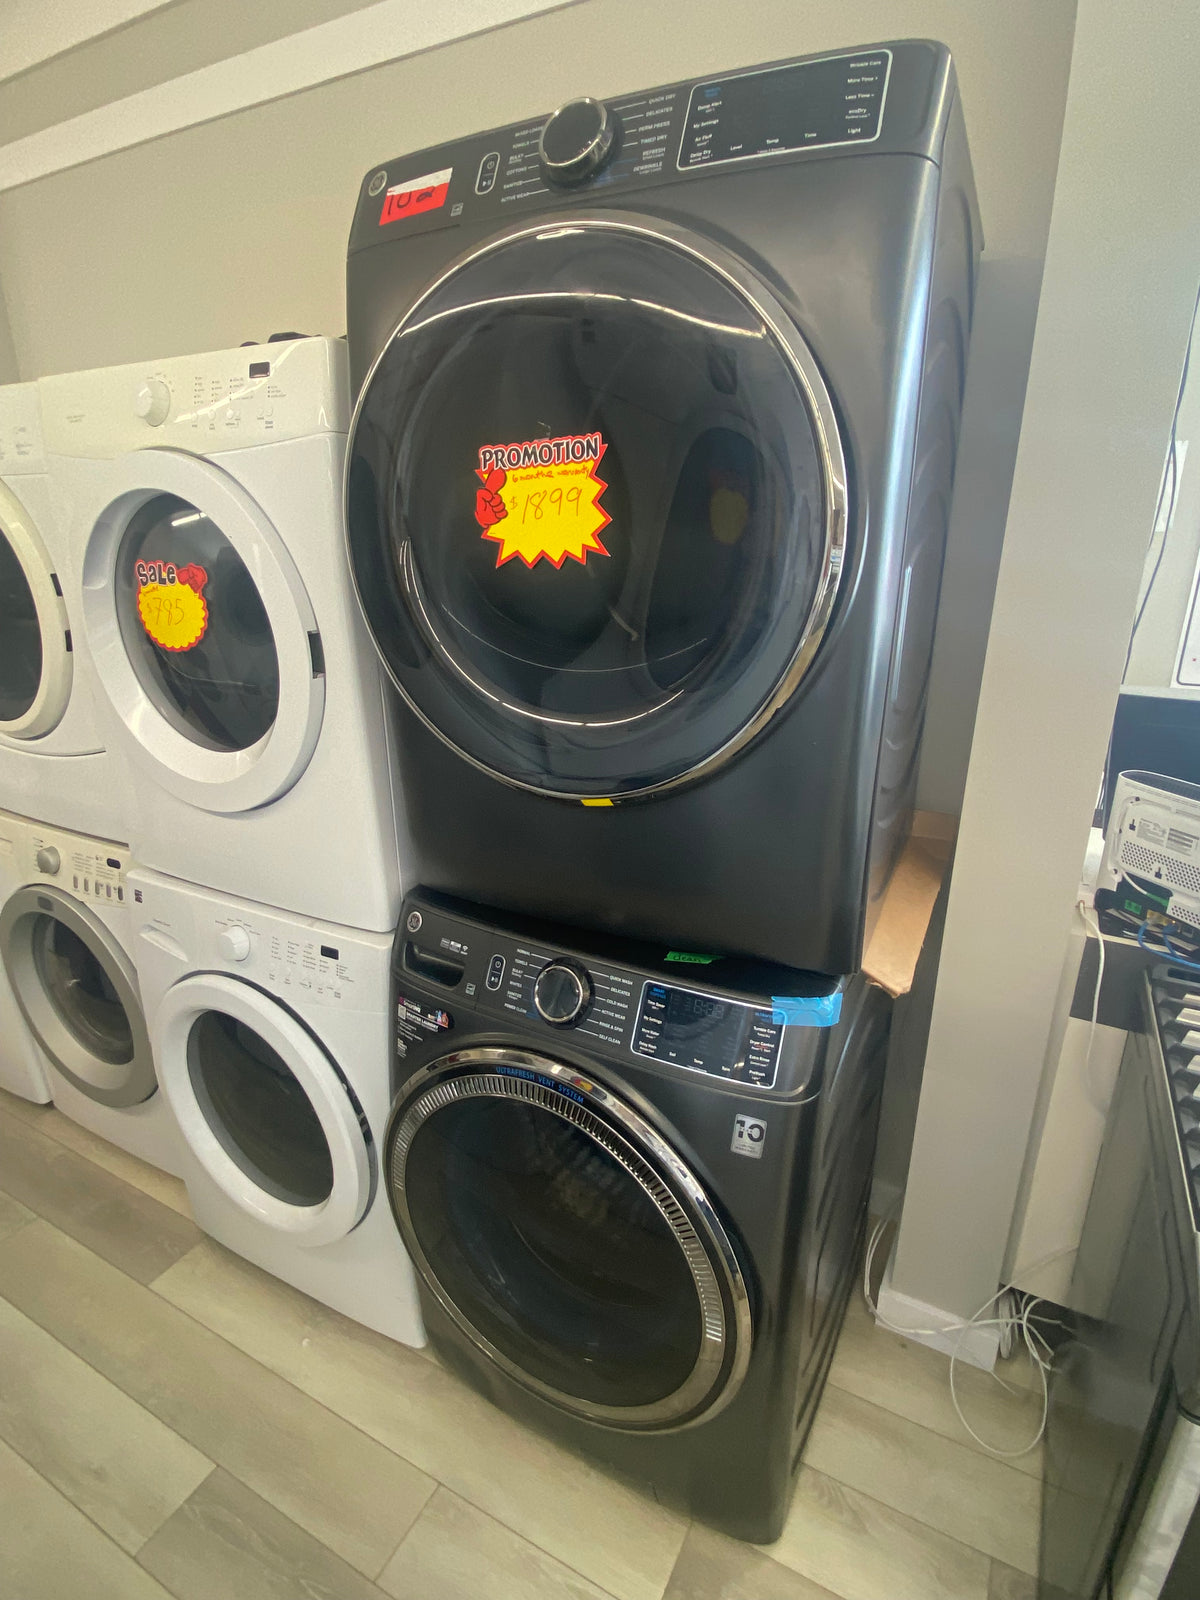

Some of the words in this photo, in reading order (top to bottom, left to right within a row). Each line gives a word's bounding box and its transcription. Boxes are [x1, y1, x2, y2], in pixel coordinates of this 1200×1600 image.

[481, 437, 600, 472] PROMOTION
[610, 986, 631, 997] DELICATES
[496, 1066, 536, 1080] ULTRAFRESH
[538, 1076, 556, 1088] VENT
[558, 1084, 585, 1104] SYSTEM
